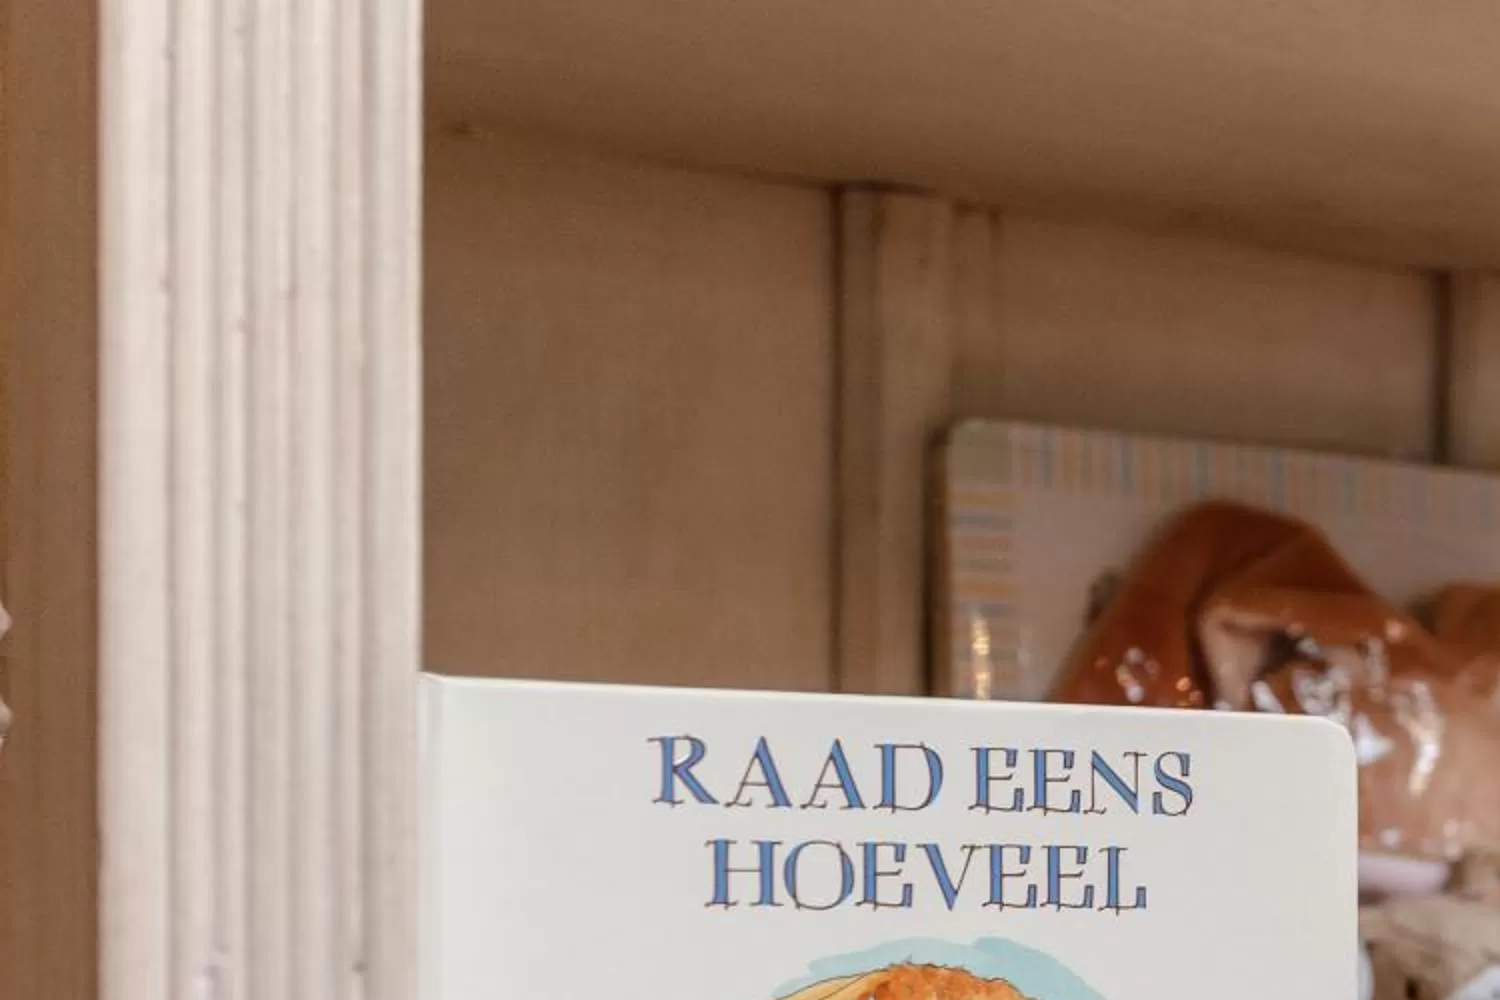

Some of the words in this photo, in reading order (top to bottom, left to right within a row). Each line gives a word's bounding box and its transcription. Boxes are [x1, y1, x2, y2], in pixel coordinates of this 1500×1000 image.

[646, 734, 944, 814] RAAD
[967, 746, 1194, 817] EENS
[703, 838, 1148, 916] HOEVEEL
